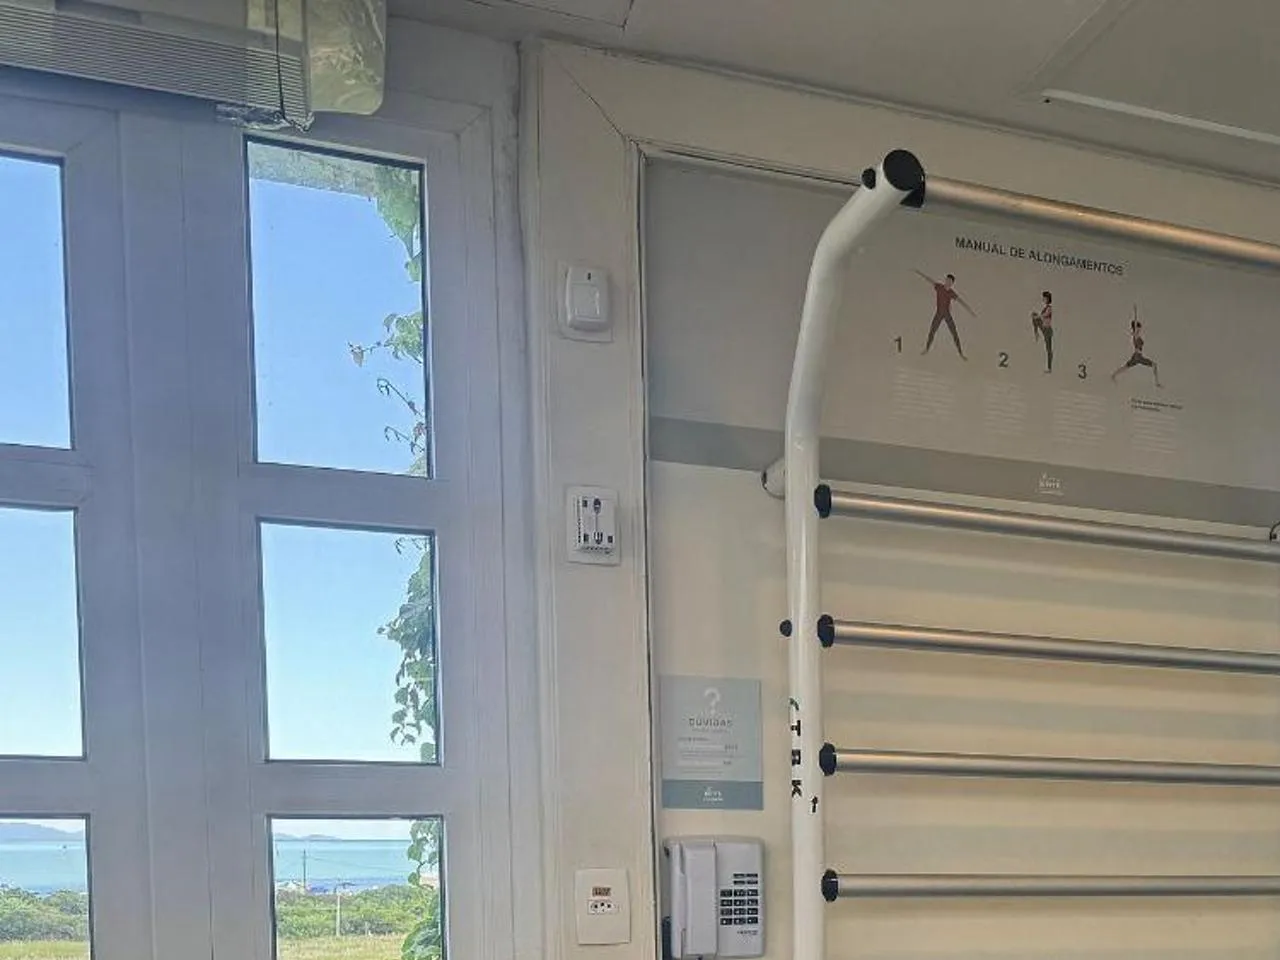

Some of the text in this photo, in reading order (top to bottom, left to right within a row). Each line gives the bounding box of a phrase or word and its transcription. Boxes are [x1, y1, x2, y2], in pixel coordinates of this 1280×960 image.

[955, 236, 1124, 276] MANUAL DE ALONGAMENTOS
[894, 335, 902, 353] 1
[998, 352, 1009, 368] 2
[1077, 363, 1087, 379] 3
